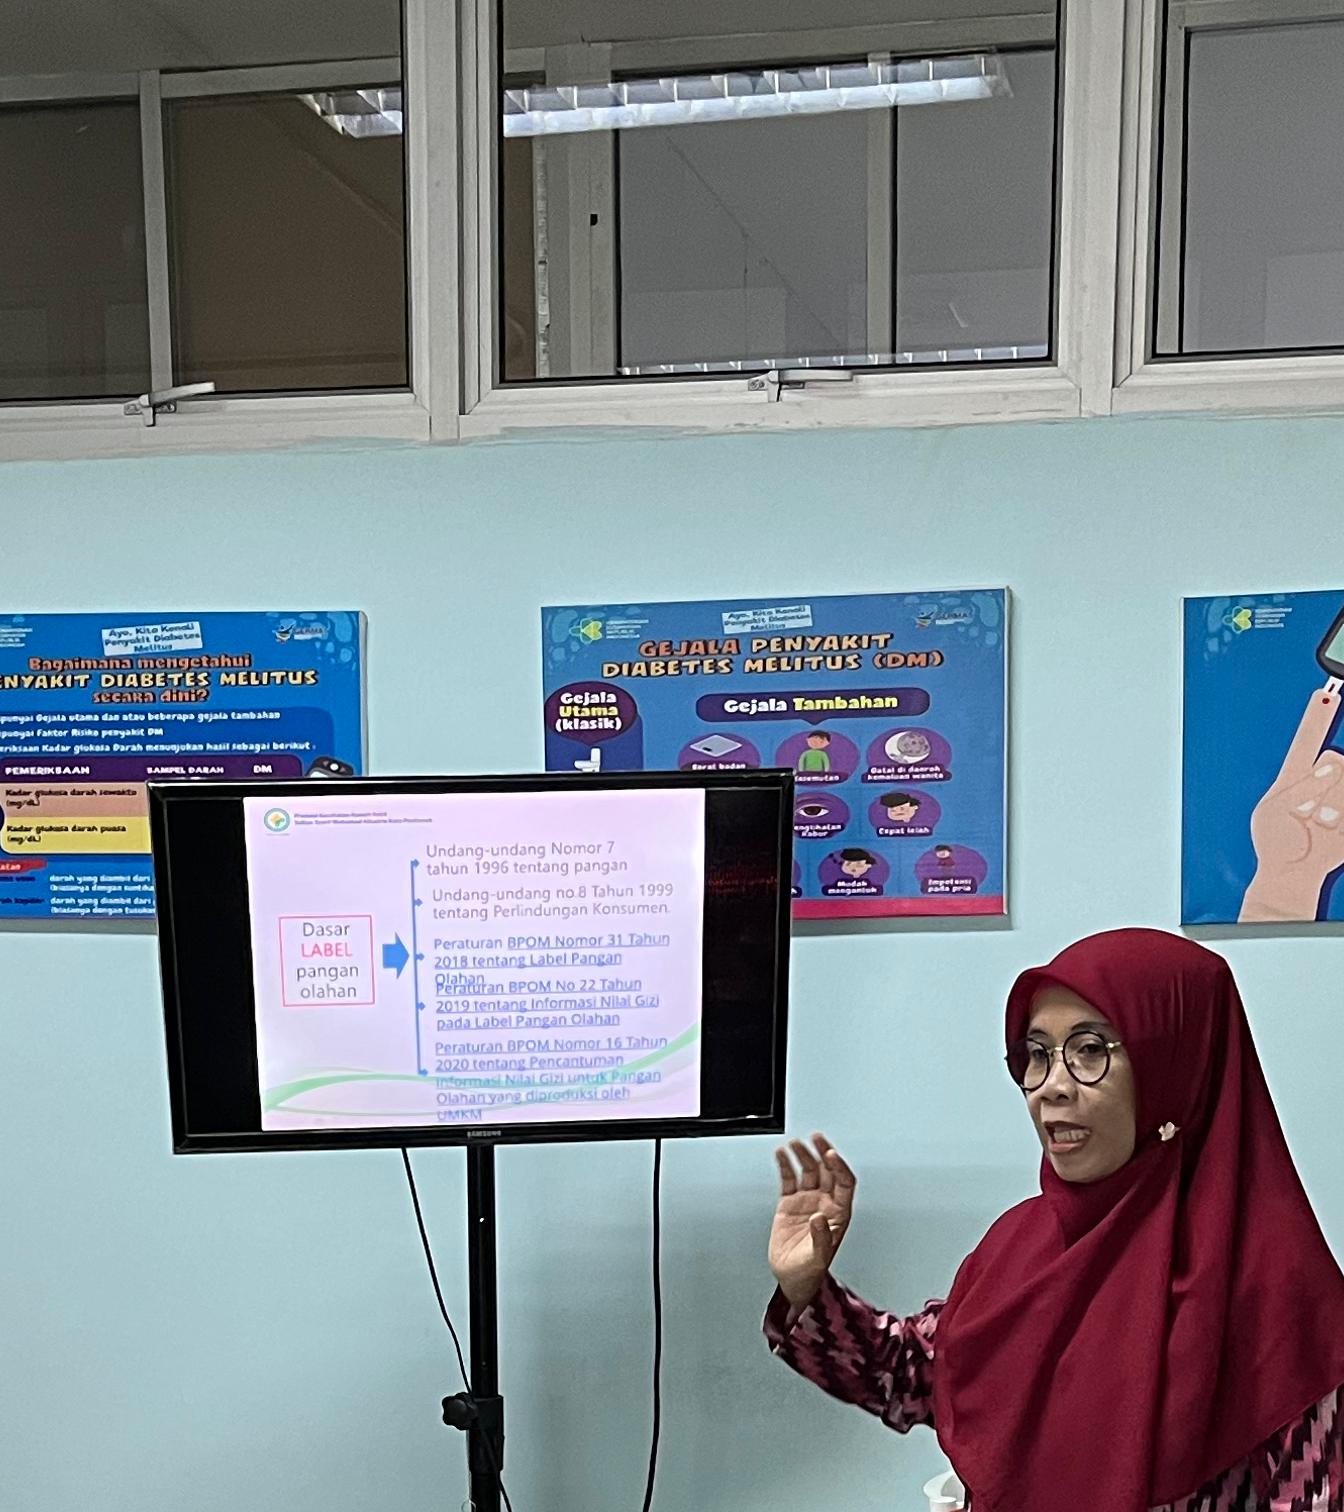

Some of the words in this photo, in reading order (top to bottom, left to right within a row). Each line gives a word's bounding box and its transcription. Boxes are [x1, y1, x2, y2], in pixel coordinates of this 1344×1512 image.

[639, 639, 741, 658] GEJALA
[751, 632, 894, 653] PENYAKIT
[28, 656, 131, 672] Bagaimana
[136, 653, 252, 671] mengetahui
[602, 658, 733, 678] DIABETES
[743, 653, 862, 673] MELITUS
[874, 651, 944, 669] (DM)
[101, 672, 210, 689] DIABETES
[220, 670, 318, 686] MELITUS
[160, 689, 209, 704] dini?
[561, 692, 616, 705] Gejala
[559, 705, 618, 717] Utama
[724, 698, 788, 715] Gejala
[793, 696, 898, 712] Tambahan
[555, 717, 622, 732] (klasik)
[5, 765, 90, 776] PEMERIKSAAN
[188, 765, 224, 775] DARAH
[253, 764, 273, 774] DM
[427, 843, 546, 860] Undang-undang
[551, 841, 602, 854] Nomor
[607, 841, 615, 853] 7
[427, 862, 468, 876] tahun
[475, 861, 509, 875] 1996
[513, 861, 569, 876] tentang
[575, 860, 628, 875] pangan
[433, 887, 551, 904] Undang-undang
[592, 884, 633, 897] Tahun
[640, 883, 674, 897] 1999
[433, 907, 488, 921] tentang
[494, 904, 588, 919] Perlindungan
[302, 922, 350, 937] Dasar
[301, 943, 353, 957] LABEL
[434, 938, 503, 950] Peraturan
[508, 936, 551, 949] BPOM
[556, 935, 603, 947] Nomor
[608, 934, 623, 946] 31
[629, 933, 670, 946] Tahun
[435, 956, 468, 969] 2018
[473, 955, 526, 969] tentang
[530, 953, 567, 966] Label
[572, 952, 622, 966] Pangan
[297, 965, 359, 981] pangan
[435, 973, 485, 985] Olahan
[300, 984, 357, 999] olahan
[436, 983, 504, 995] Peraturan
[509, 981, 551, 993] BPOM
[580, 980, 595, 992] 22
[600, 978, 642, 991] Tahun
[436, 1000, 470, 1013] 2019
[474, 999, 527, 1013] tentang
[532, 997, 597, 1010] Informasi
[601, 996, 632, 1008] Nilai
[635, 994, 659, 1007] Gizi
[437, 1017, 470, 1030] pada
[475, 1016, 513, 1029] Label
[516, 1015, 567, 1028] Pangan
[571, 1013, 620, 1026] Olahan
[435, 1041, 503, 1054] Peraturan
[508, 1040, 550, 1053] BPOM
[554, 1038, 601, 1051] Nomor
[606, 1037, 622, 1049] 16
[627, 1036, 667, 1049] Tahun
[435, 1059, 468, 1071] 2020
[473, 1057, 526, 1071] tentang
[530, 1055, 624, 1068] Pencantuman
[507, 1073, 535, 1087] Nilai
[539, 1073, 563, 1085] Gizi
[568, 1071, 605, 1084] untuk
[612, 1069, 661, 1084] Pangan
[437, 1091, 485, 1105] Olahan
[489, 1093, 521, 1104] yang
[526, 1088, 598, 1102] diproduksi
[602, 1086, 630, 1100] oleh
